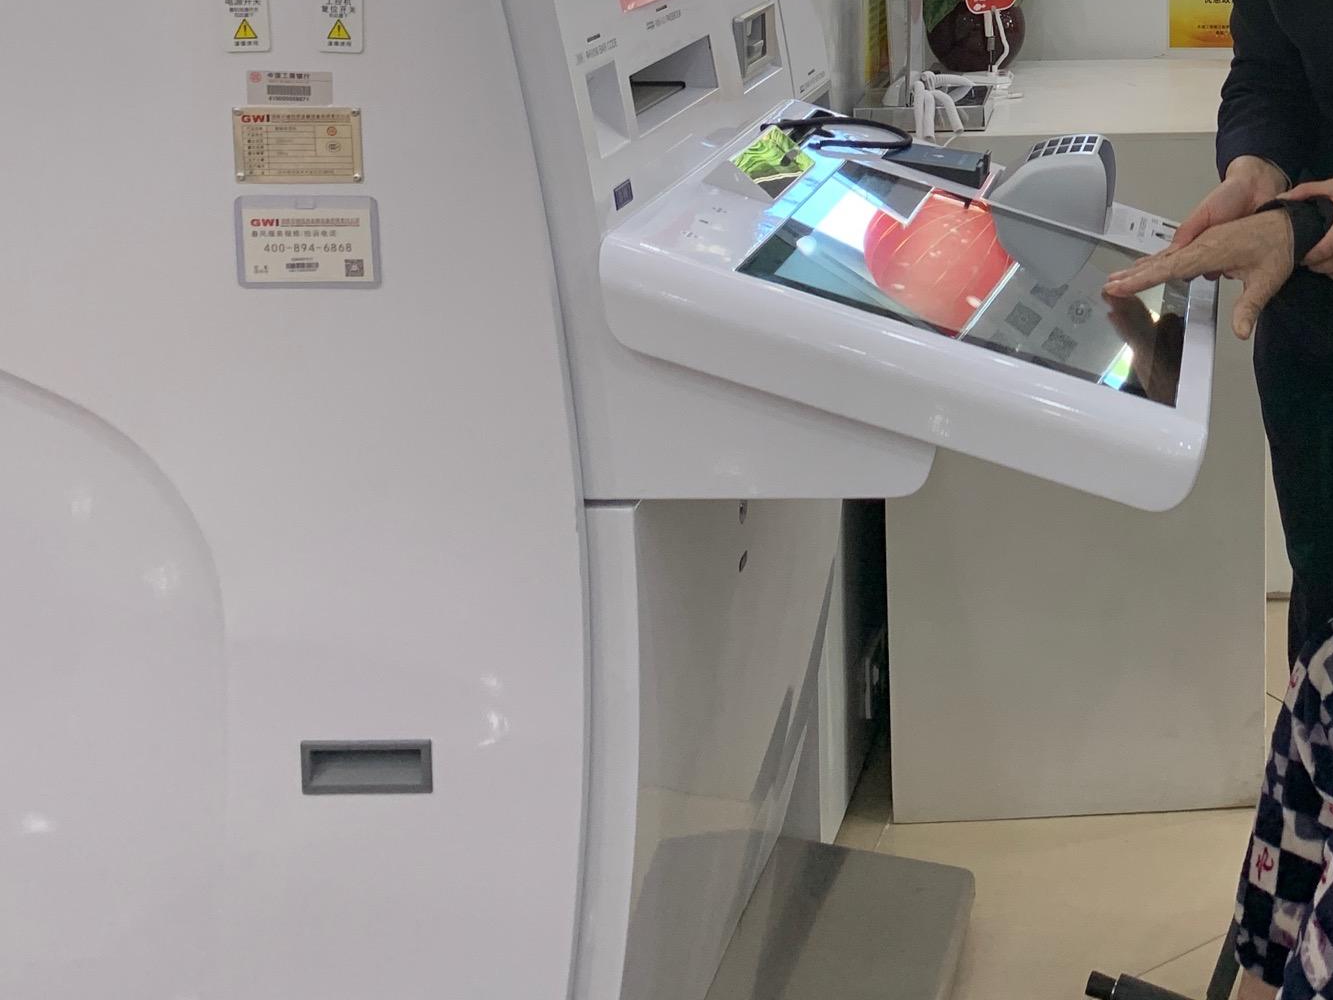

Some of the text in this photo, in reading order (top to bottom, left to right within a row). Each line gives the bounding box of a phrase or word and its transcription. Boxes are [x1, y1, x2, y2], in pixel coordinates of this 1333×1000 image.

[240, 114, 271, 124] GWI
[250, 218, 280, 227] GWI
[263, 242, 353, 254] 400-894-6868
